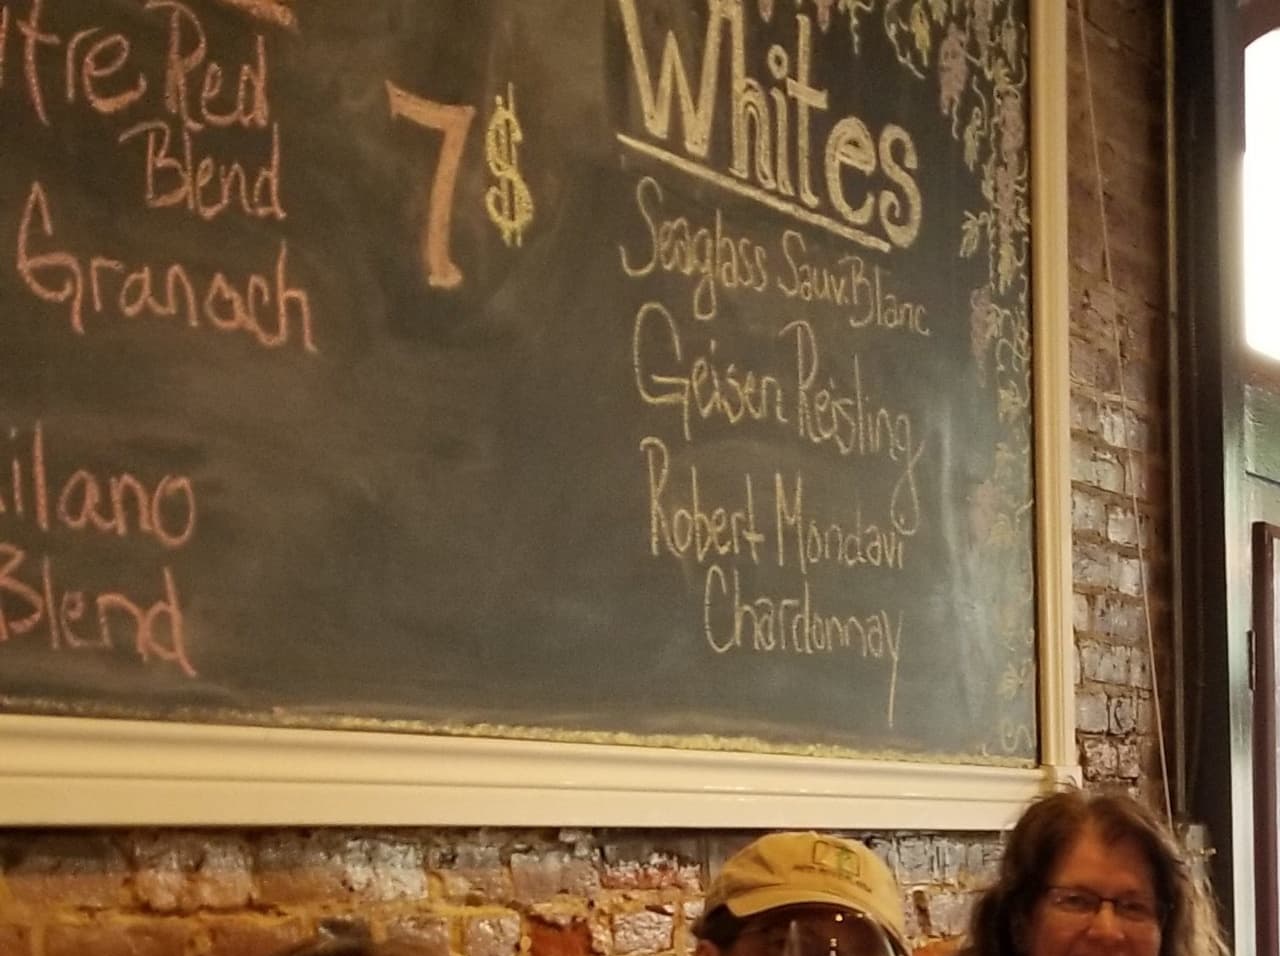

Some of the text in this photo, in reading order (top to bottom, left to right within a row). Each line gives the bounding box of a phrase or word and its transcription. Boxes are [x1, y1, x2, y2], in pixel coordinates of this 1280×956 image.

[0, 0, 269, 130] tre Red
[617, 0, 922, 249] Whites
[118, 120, 286, 220] Blend
[619, 176, 768, 320] Seaglass
[634, 302, 789, 441] Geisen
[0, 418, 196, 547] ilano
[640, 436, 905, 575] Robert Mondavi
[0, 541, 198, 678] Blend
[704, 565, 900, 728] Chardonnay
